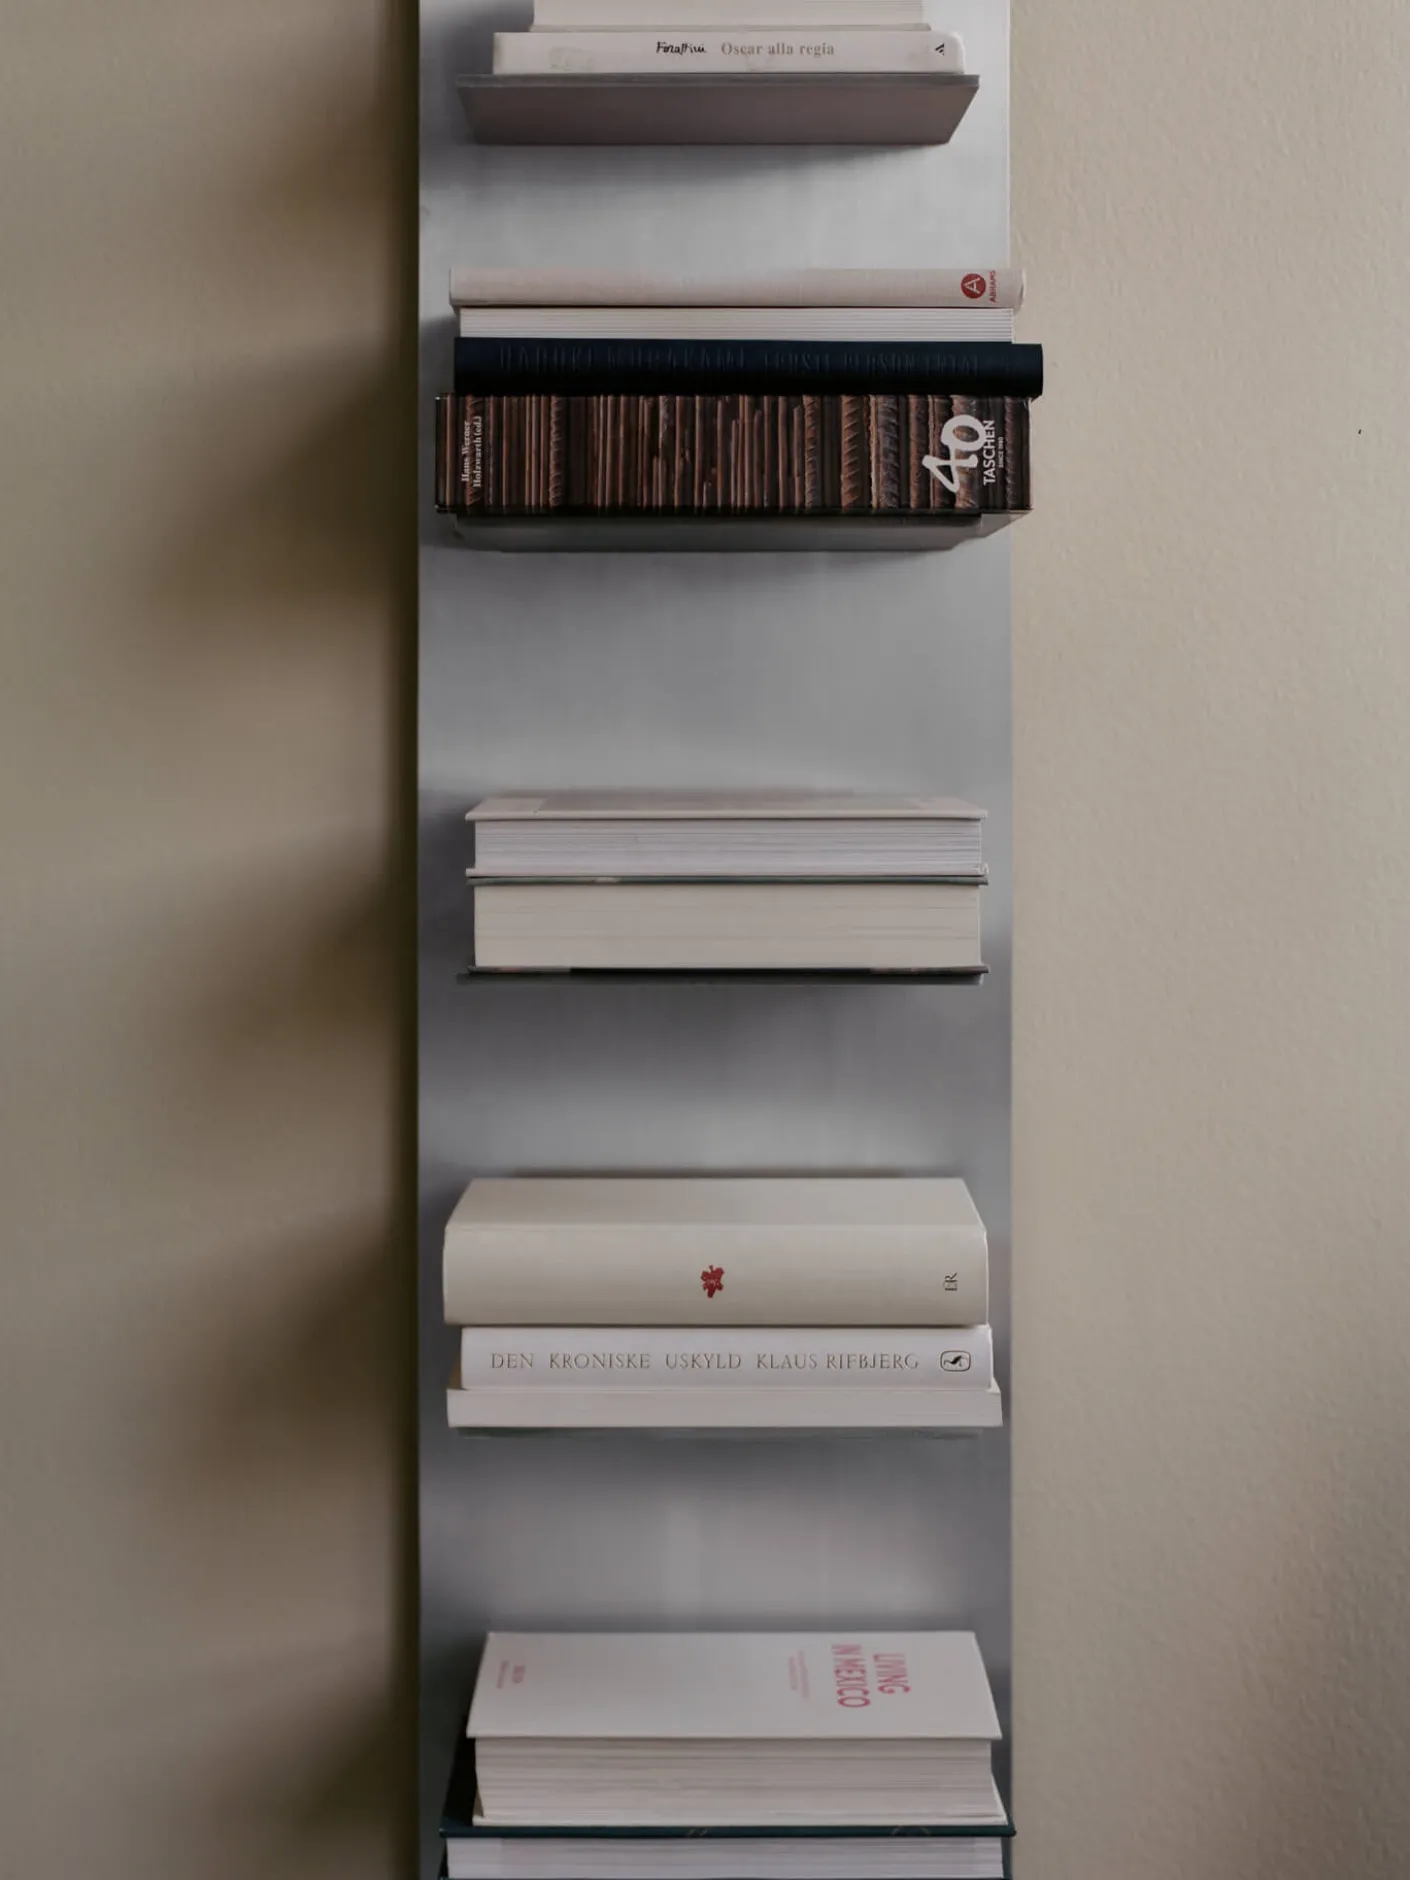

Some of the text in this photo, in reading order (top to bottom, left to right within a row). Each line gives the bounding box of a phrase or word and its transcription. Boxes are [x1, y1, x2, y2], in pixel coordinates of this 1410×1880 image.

[721, 42, 835, 58] Oscar alla regia
[989, 270, 997, 304] ABRAMS
[461, 420, 471, 482] Hans Werner
[473, 437, 482, 488] Holzwarth
[922, 414, 987, 493] 40
[983, 420, 996, 486] TASCHEN
[491, 1353, 919, 1370] DEN KRONISKE USKYLD KLAUS RIFBJERG
[833, 1658, 870, 1708] MEXICO
[872, 1653, 910, 1694] LIVING
